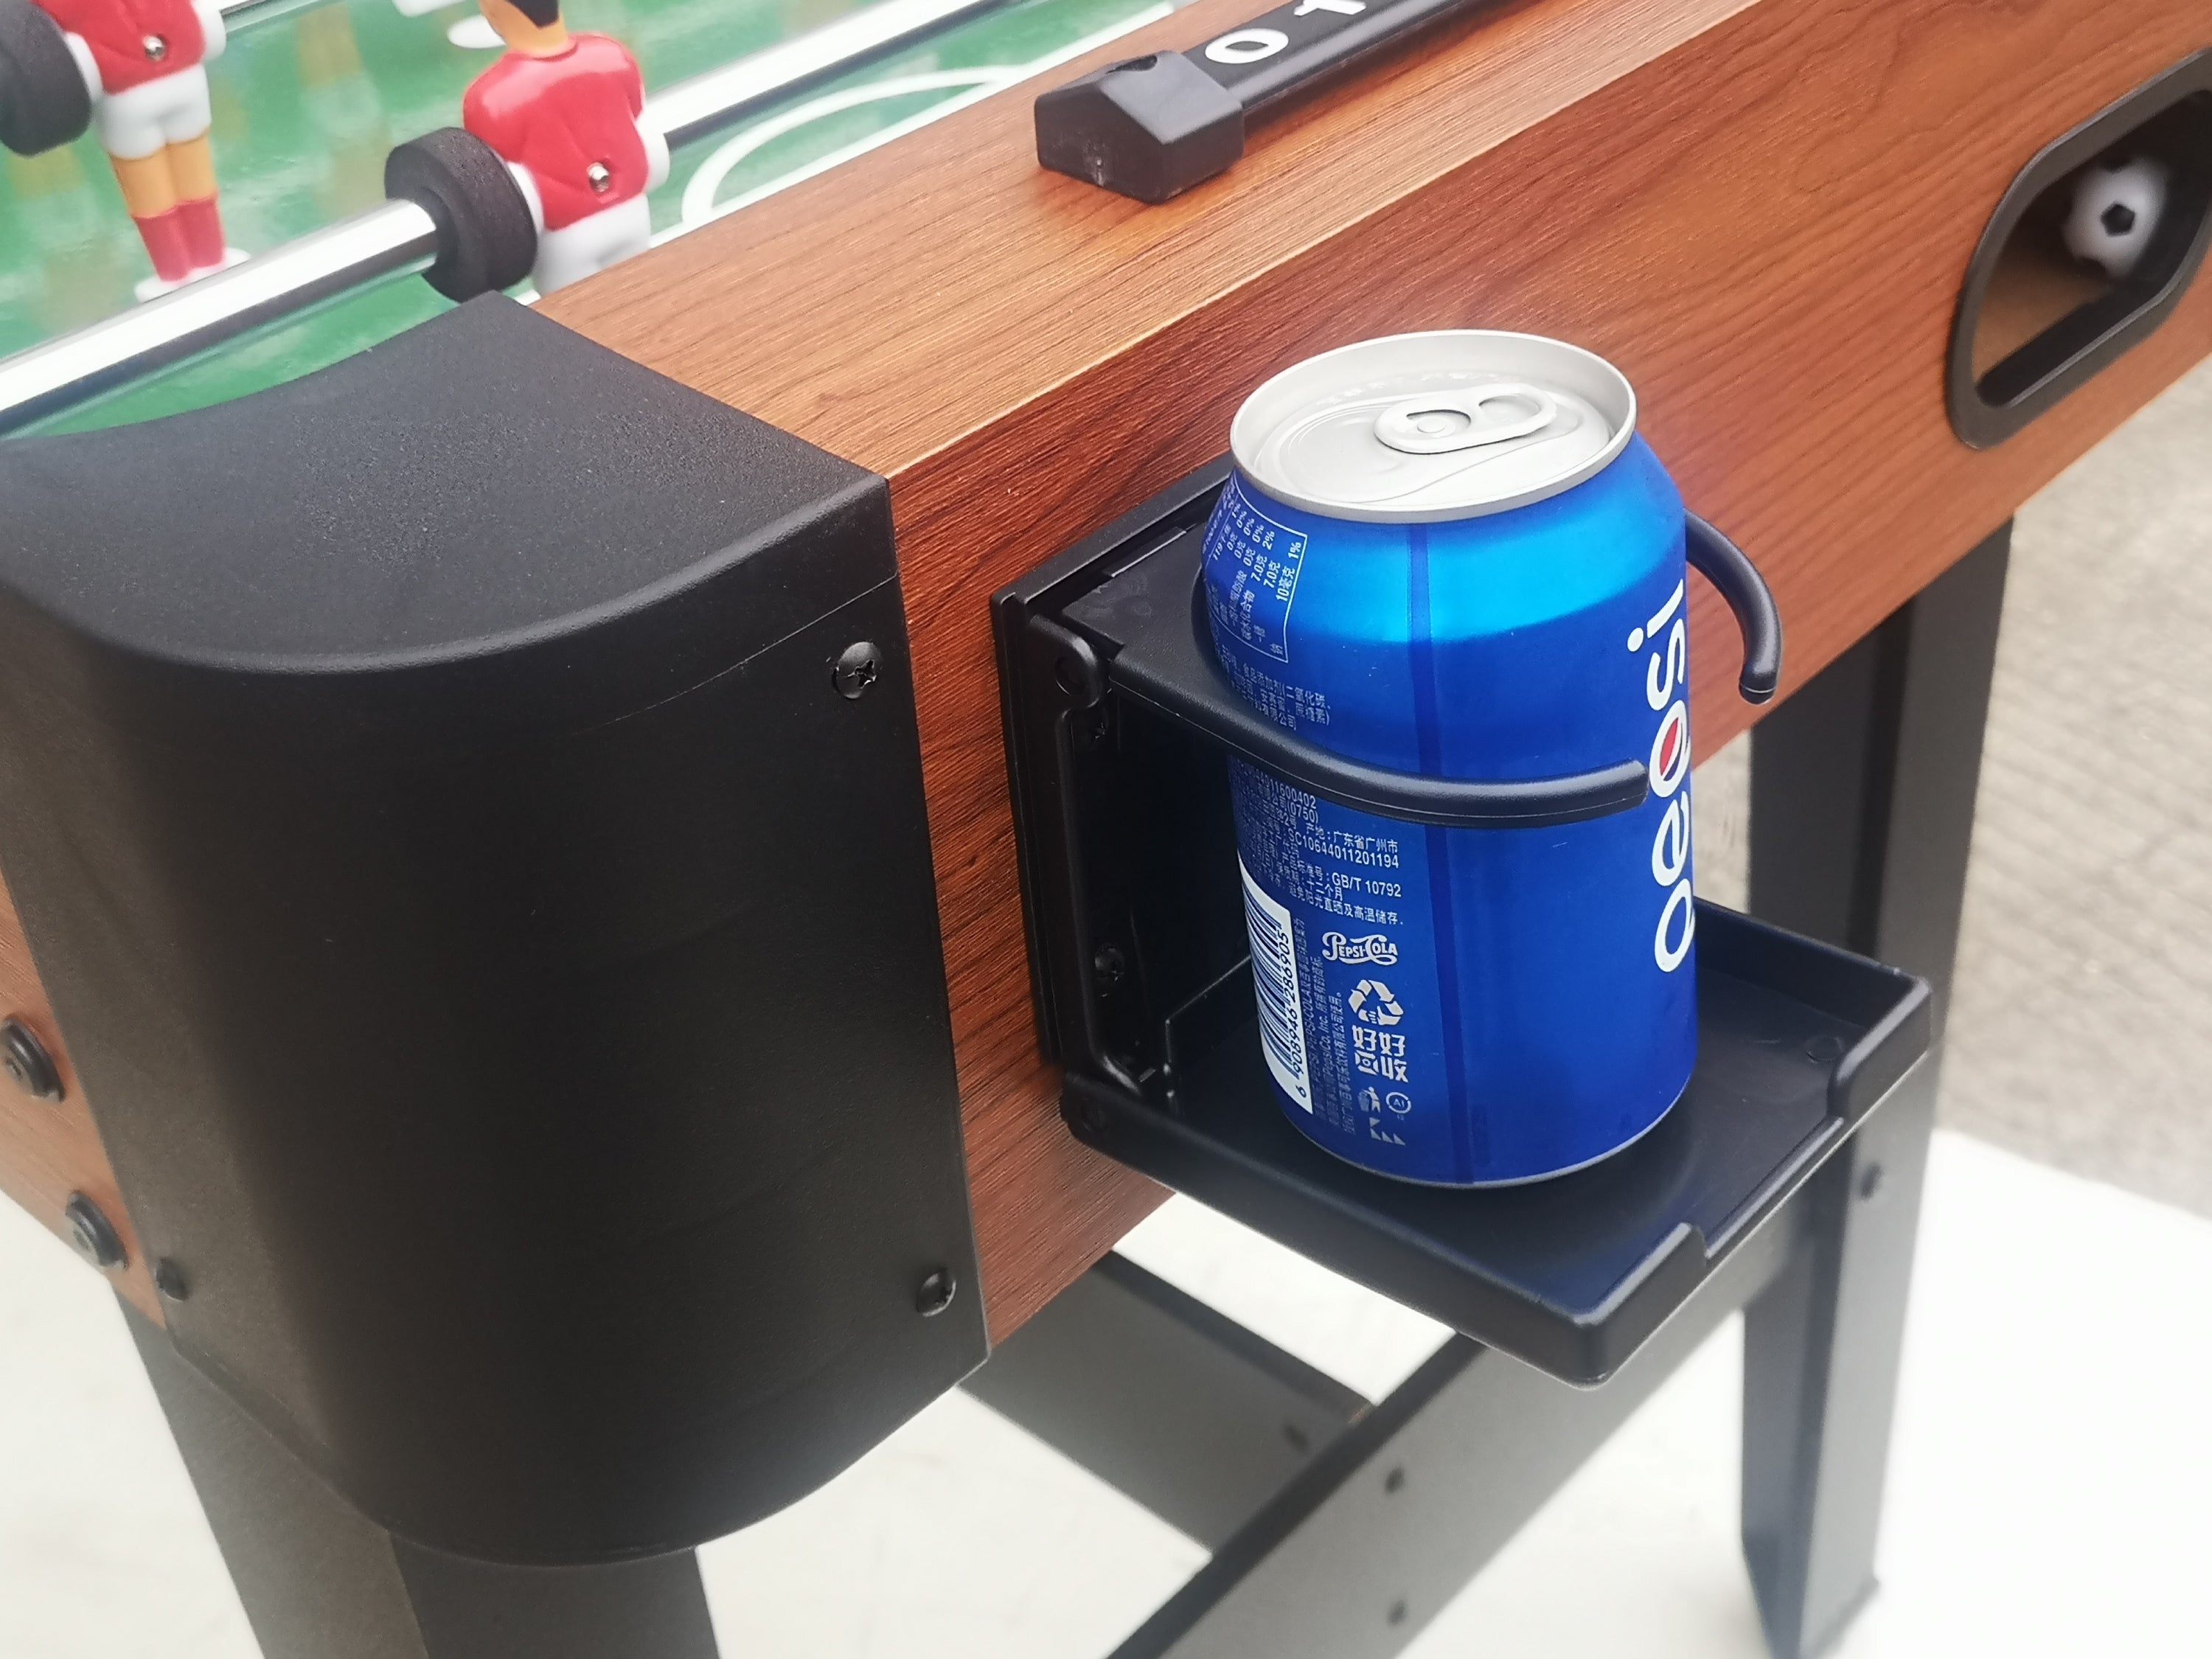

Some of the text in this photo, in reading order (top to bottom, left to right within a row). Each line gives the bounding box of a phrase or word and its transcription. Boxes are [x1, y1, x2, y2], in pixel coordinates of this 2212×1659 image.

[1205, 28, 1289, 64] 0
[1262, 531, 1275, 550] 2%
[1288, 542, 1301, 560] 1%
[1366, 880, 1402, 898] 10792
[1277, 929, 1307, 1098] 6 908946 286905
[1352, 1025, 1406, 1057] 好好
